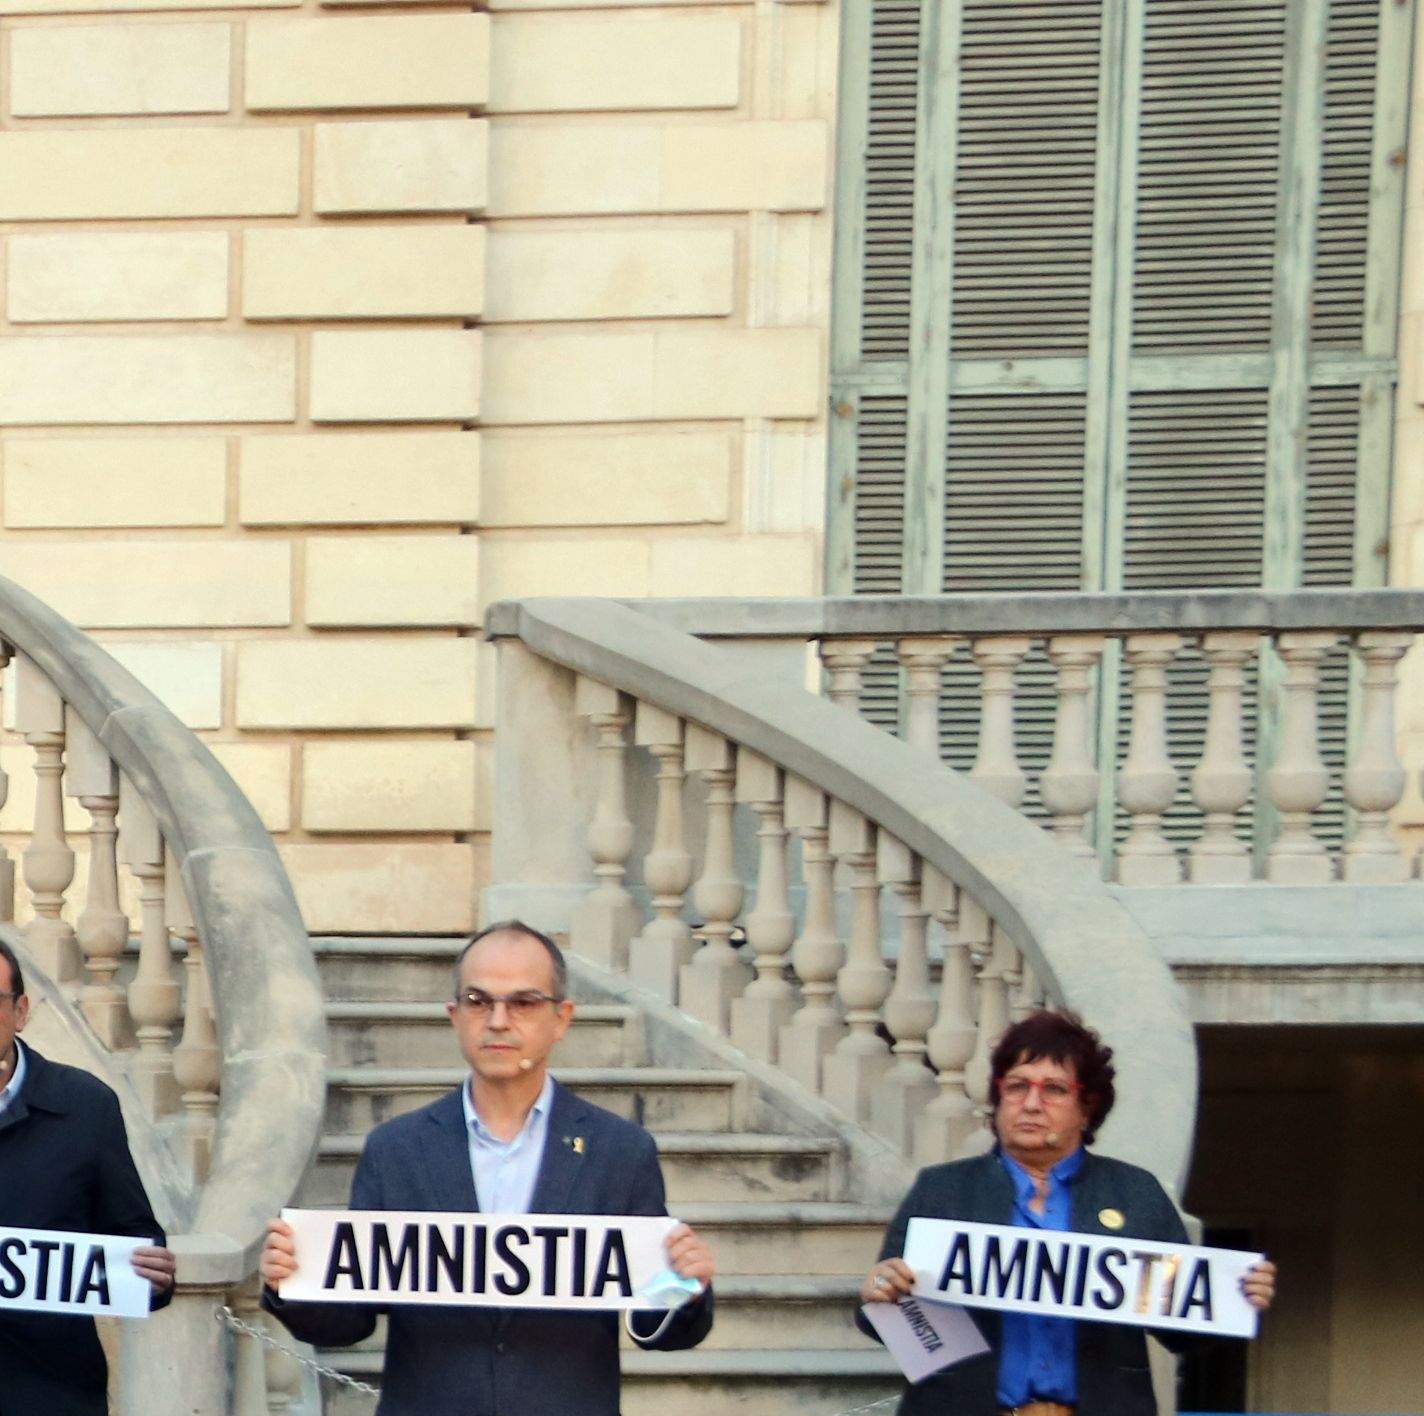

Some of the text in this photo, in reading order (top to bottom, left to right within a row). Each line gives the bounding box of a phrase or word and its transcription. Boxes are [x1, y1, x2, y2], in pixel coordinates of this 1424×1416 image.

[324, 1222, 633, 1297] AMNISTIA
[938, 1232, 1212, 1321] AMNISTIA
[899, 1300, 943, 1353] AMNISTIA
